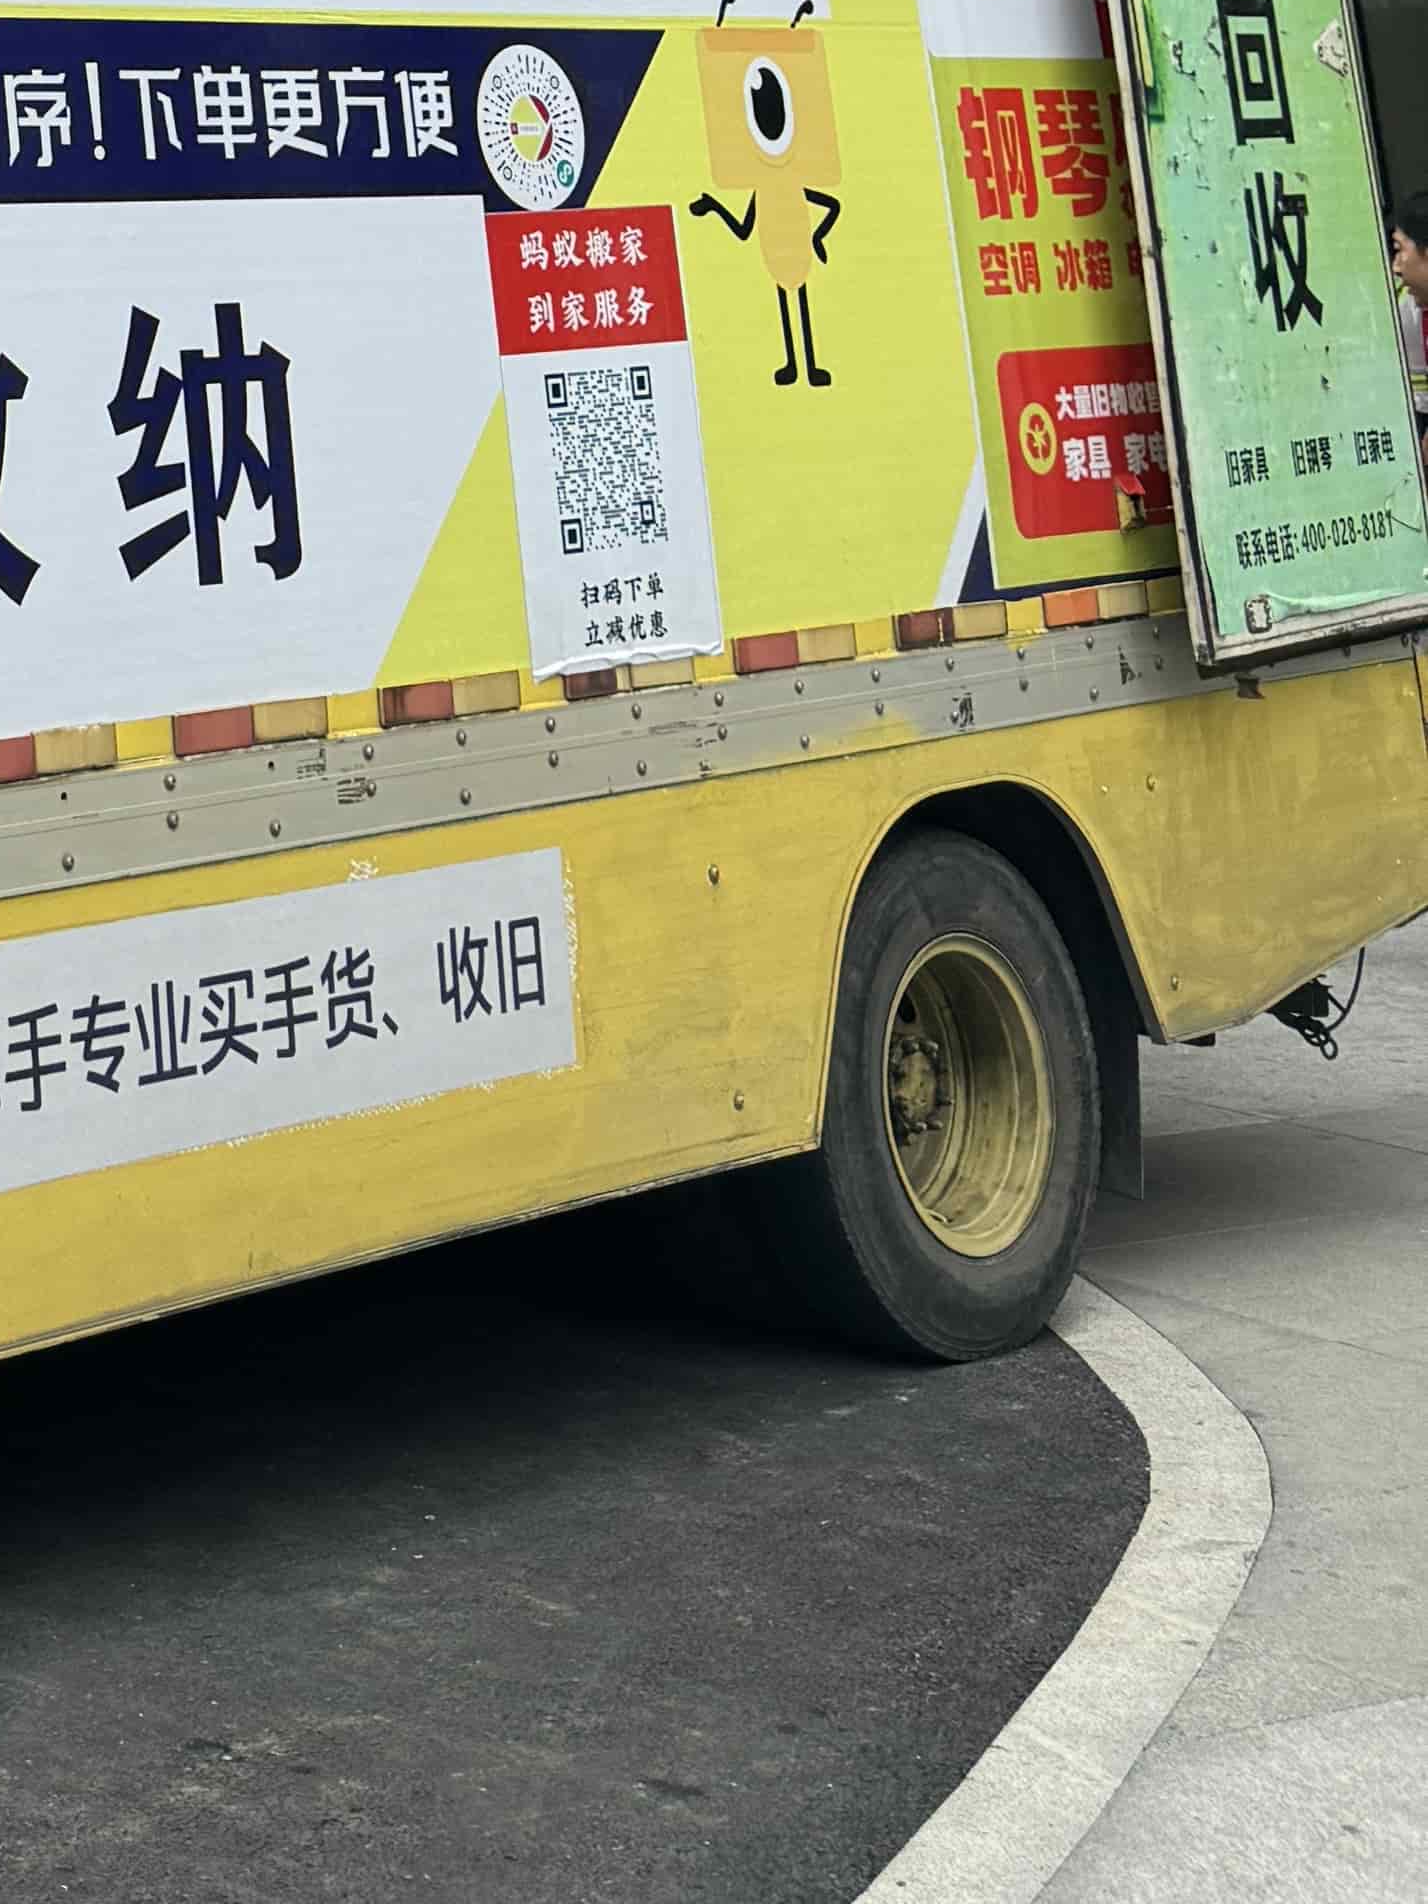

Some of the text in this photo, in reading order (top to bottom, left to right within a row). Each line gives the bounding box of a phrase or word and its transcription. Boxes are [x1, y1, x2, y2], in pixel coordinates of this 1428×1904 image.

[956, 87, 1137, 220] 钢琴
[519, 225, 648, 271] 蚂蚁搬家
[978, 241, 1042, 297] 空调
[1052, 238, 1113, 292] 冰箱
[527, 285, 654, 334] 到家服务
[1062, 435, 1112, 482] 家具
[1225, 427, 1396, 488] 旧家具 旧钢琴 旧家电
[580, 571, 665, 609] 扫码下单
[585, 610, 668, 647] 立减优惠
[436, 914, 546, 1024] 收旧
